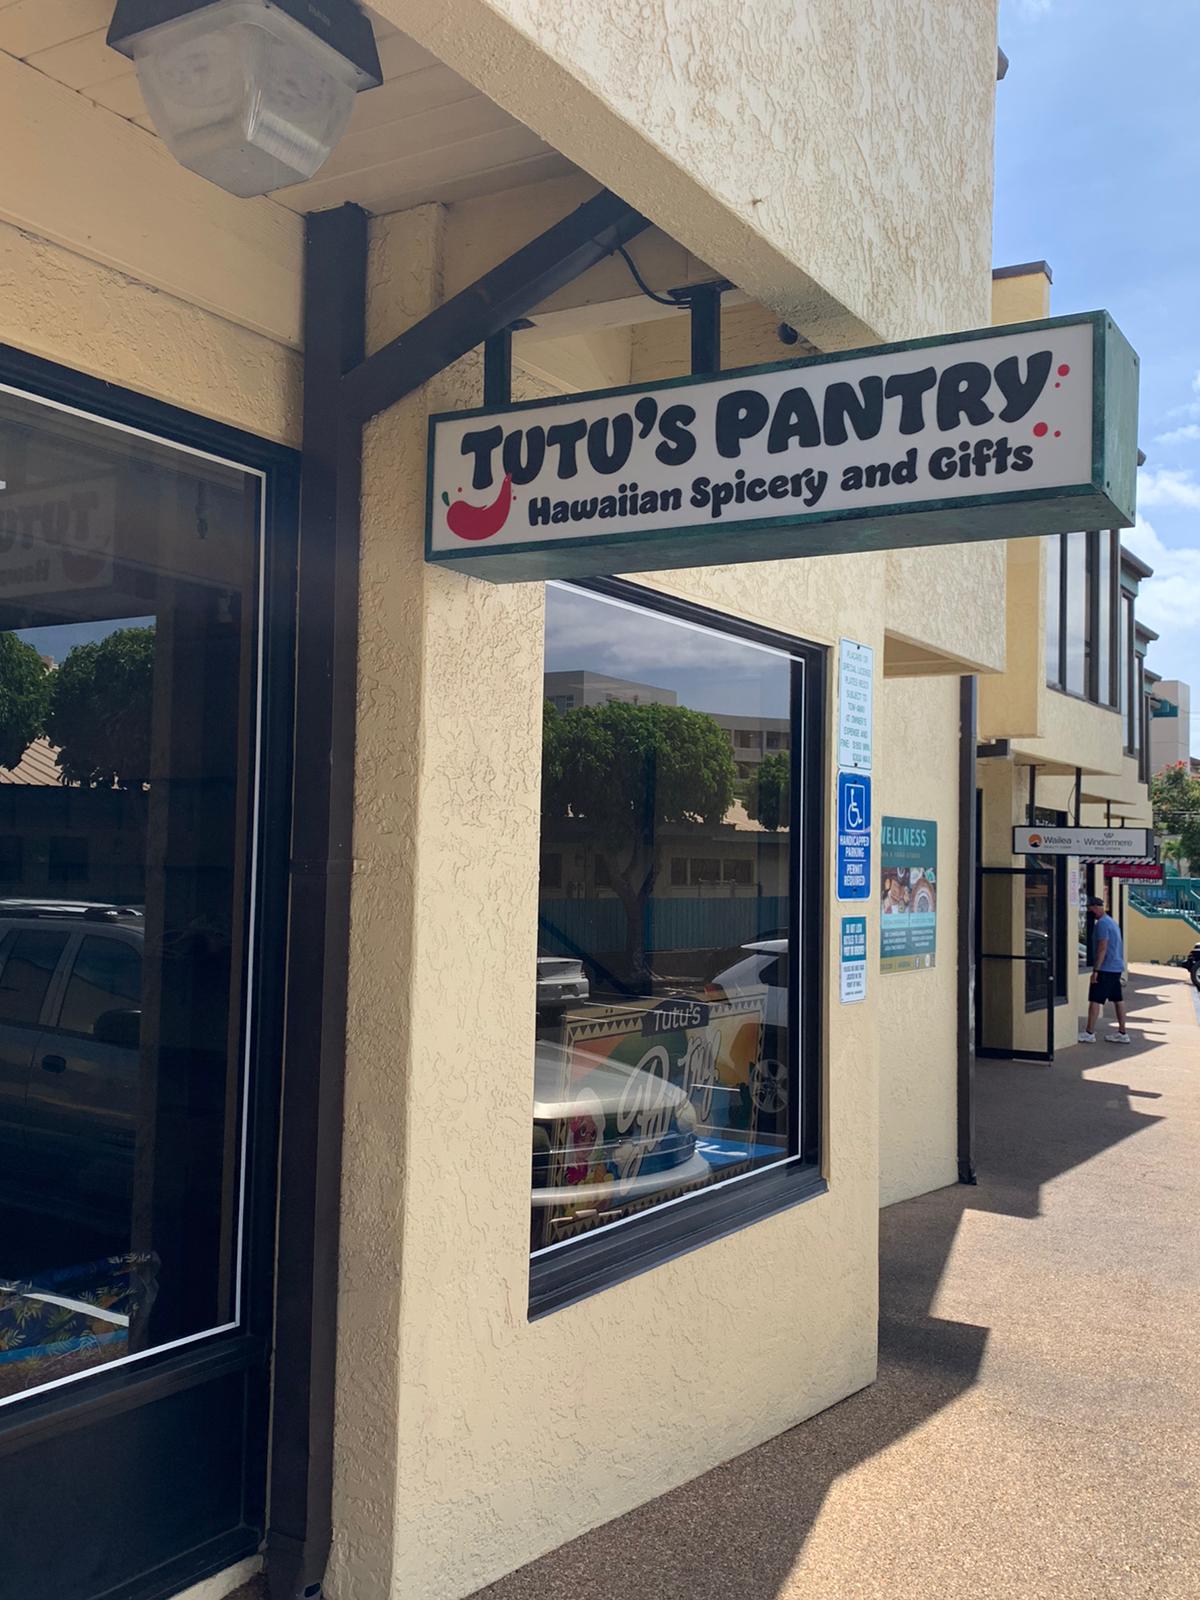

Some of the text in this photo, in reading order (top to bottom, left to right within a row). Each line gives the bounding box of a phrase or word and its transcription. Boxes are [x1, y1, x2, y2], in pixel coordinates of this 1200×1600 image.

[460, 350, 1054, 491] TUTU'S PANTRY
[527, 435, 1034, 528] Hawaiian Spicery and Gifts
